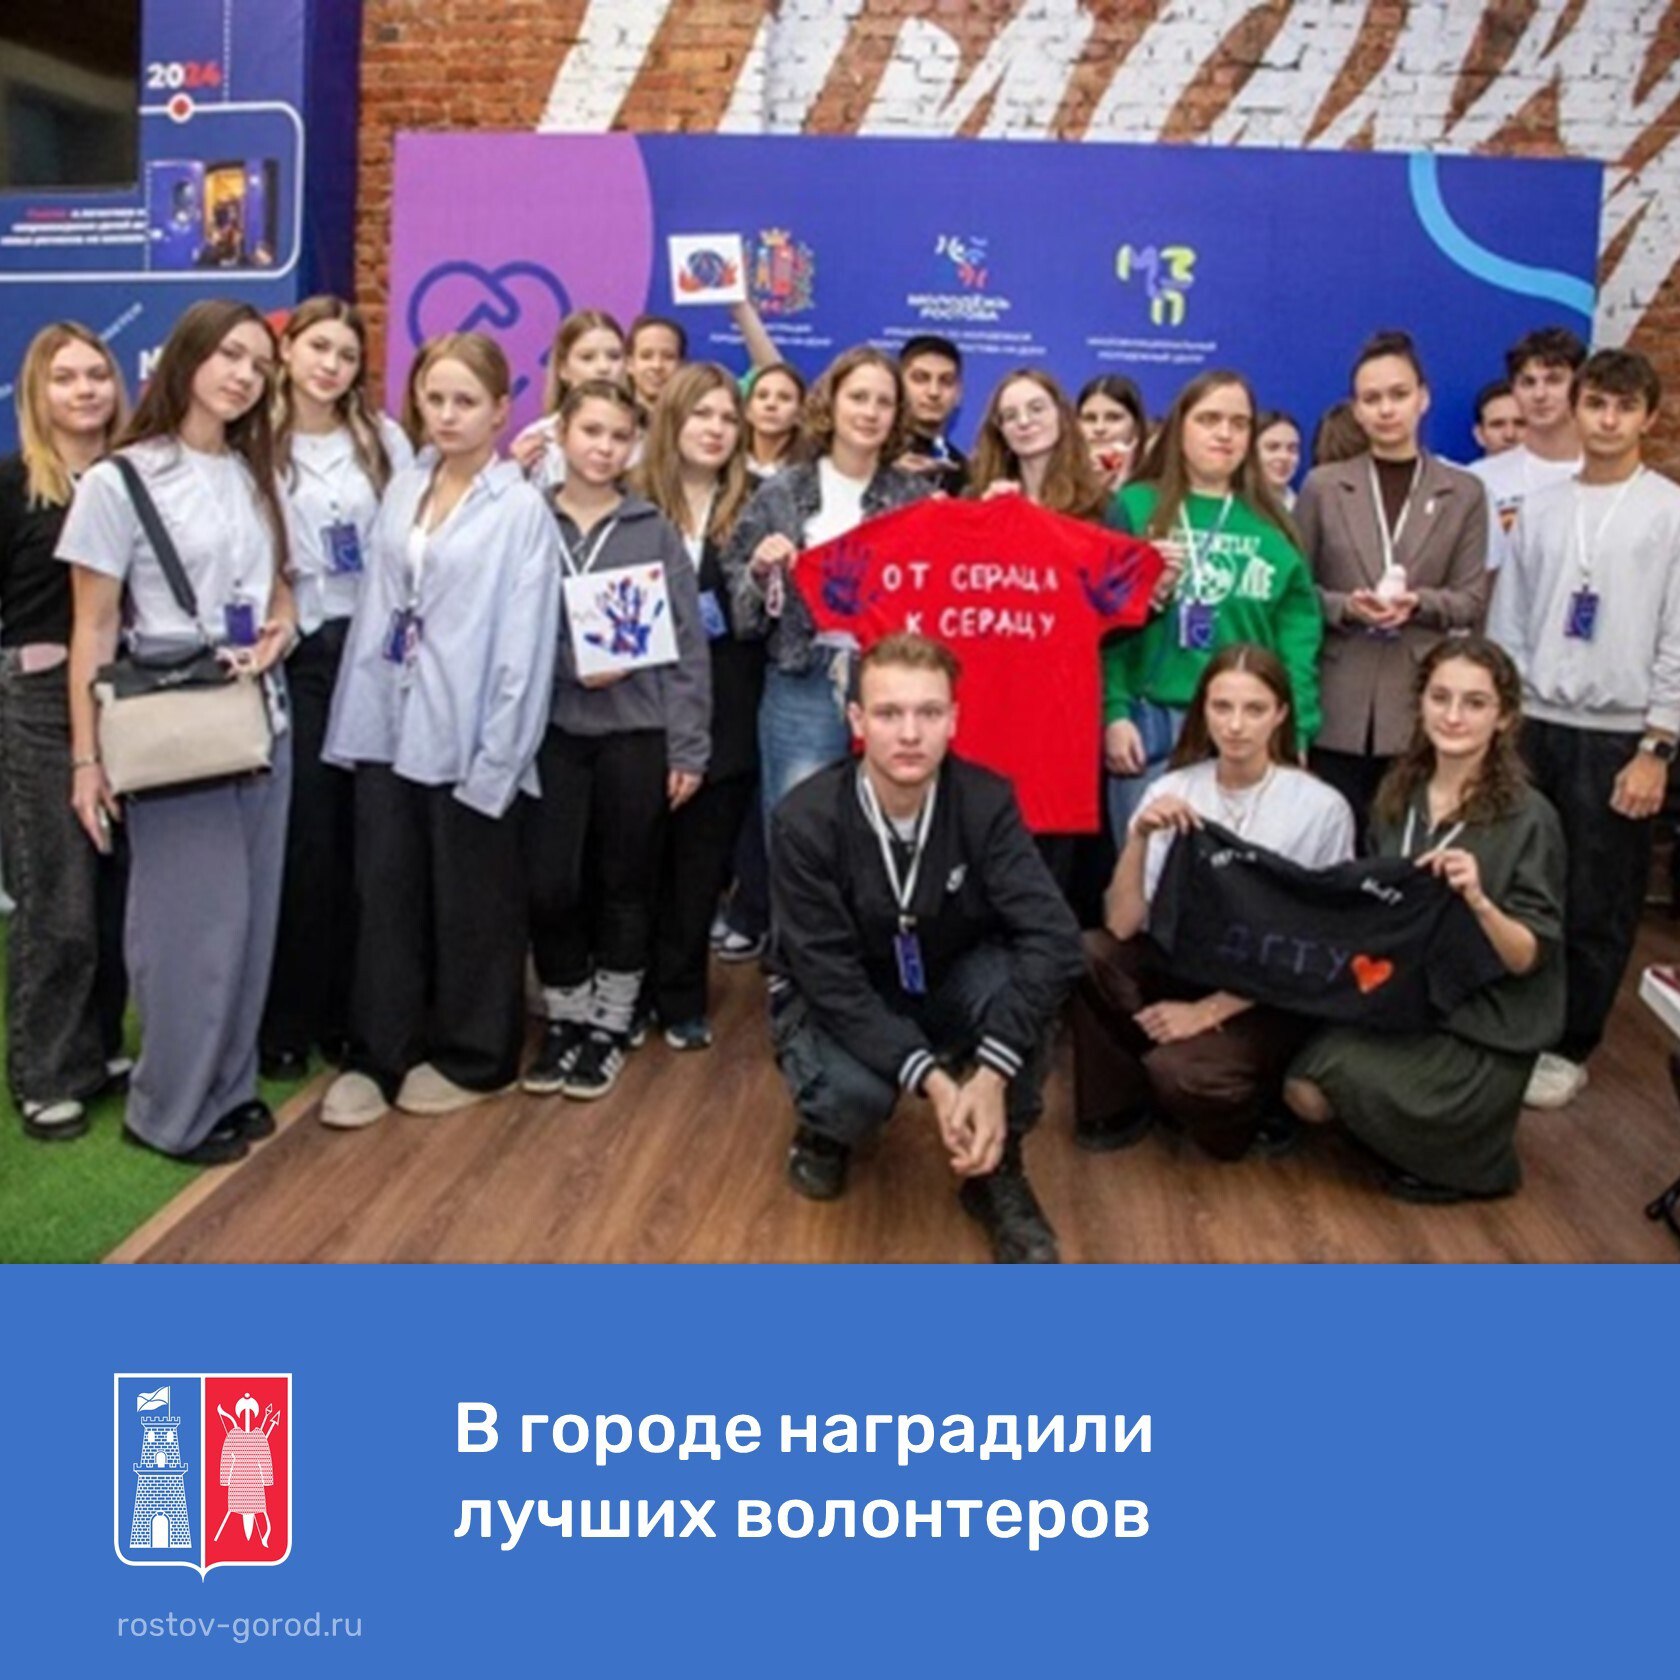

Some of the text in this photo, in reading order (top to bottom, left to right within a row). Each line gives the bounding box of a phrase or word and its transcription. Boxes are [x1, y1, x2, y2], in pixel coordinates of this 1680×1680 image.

[147, 60, 221, 90] 2024
[882, 562, 931, 591] ОТ
[905, 610, 923, 635] К
